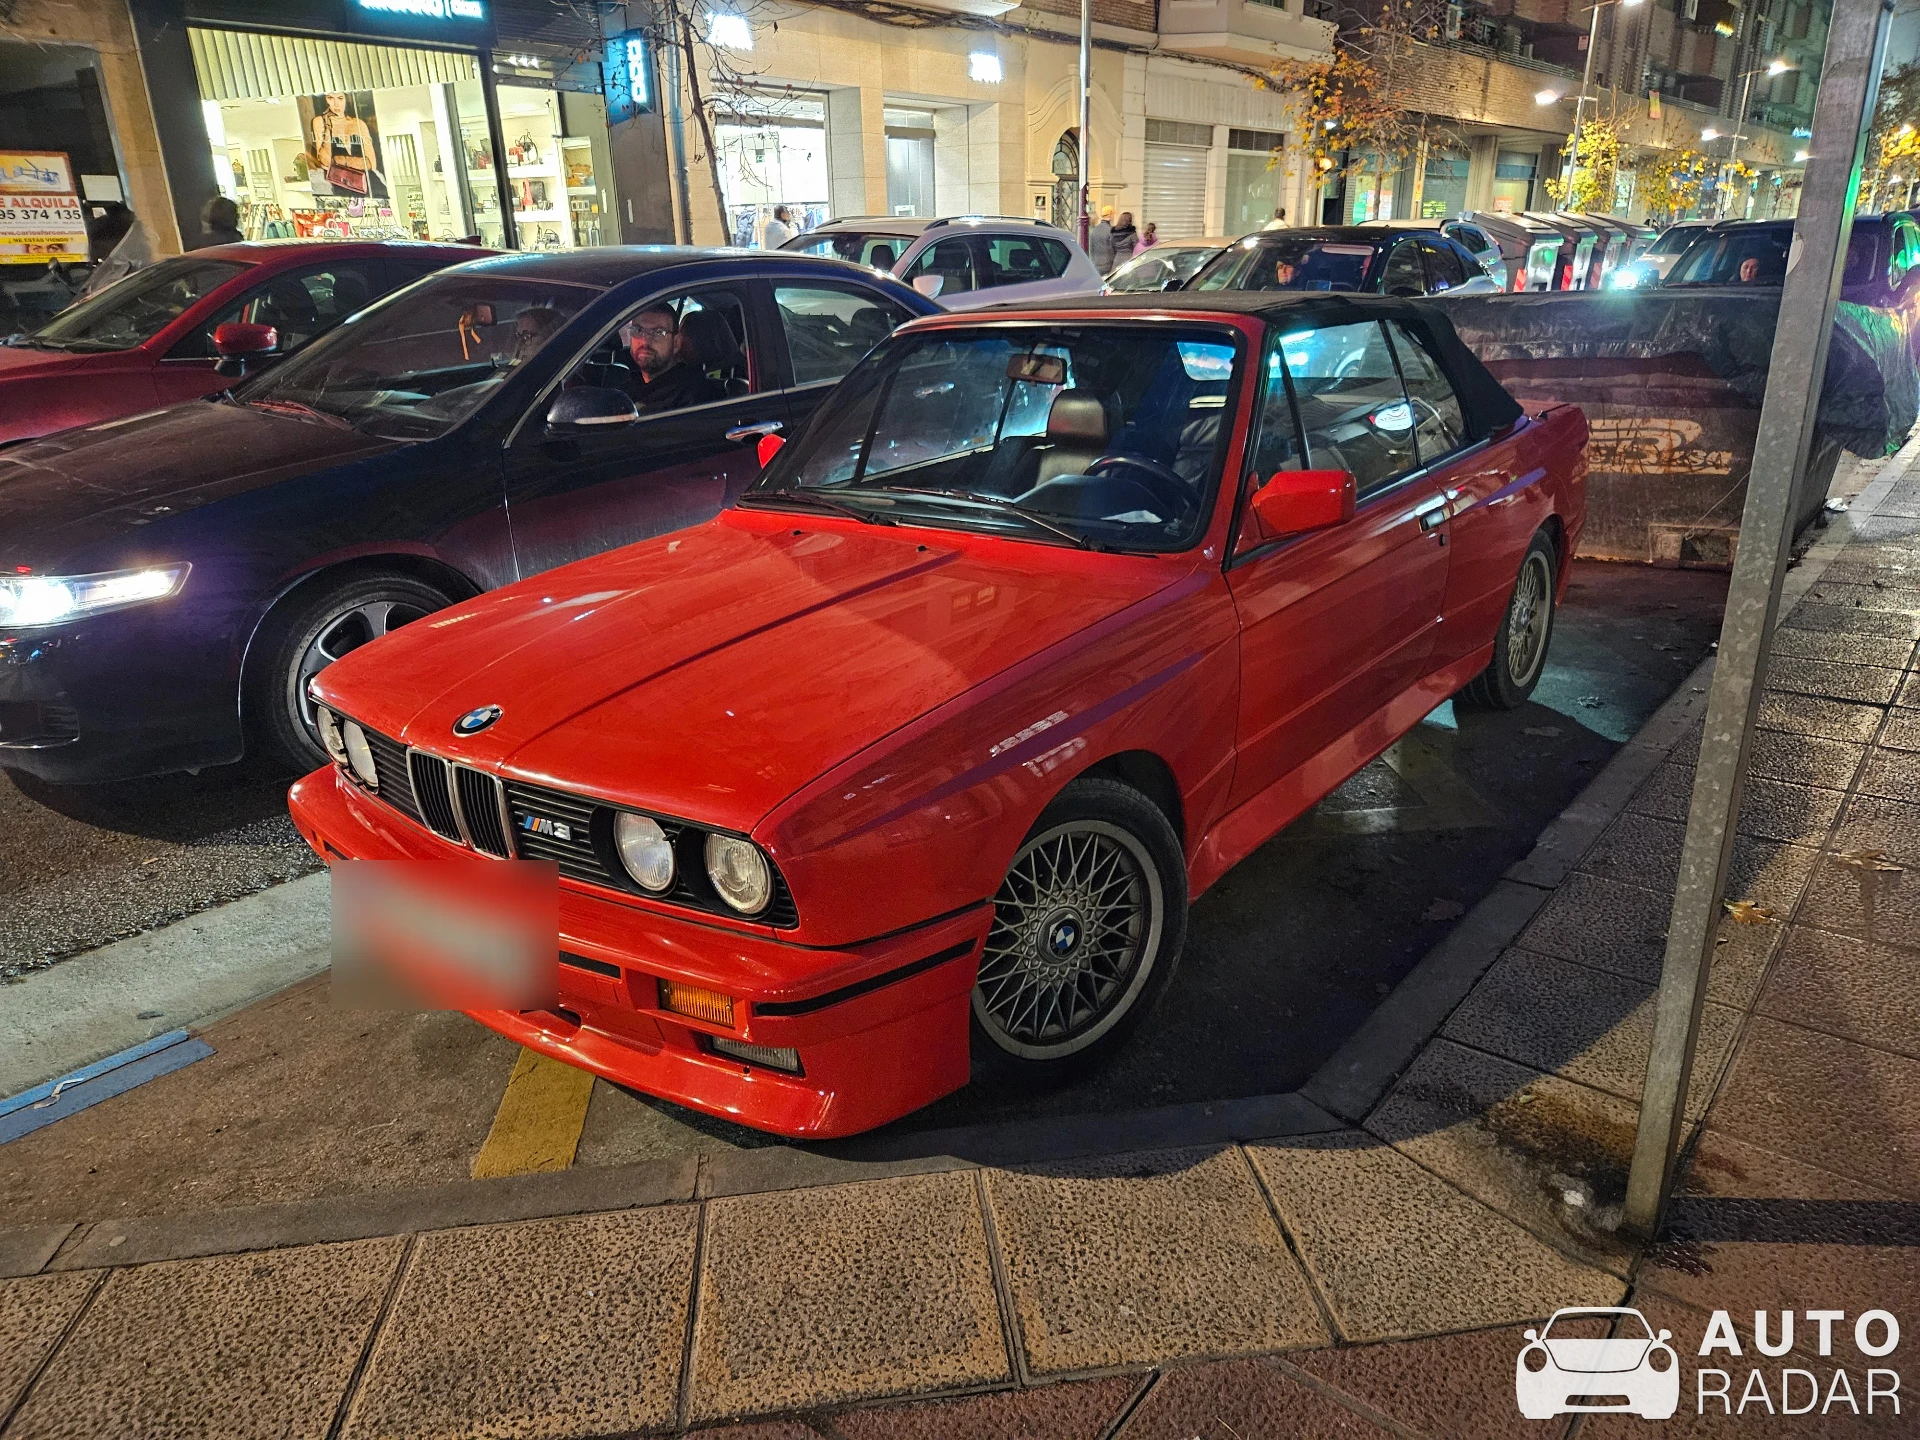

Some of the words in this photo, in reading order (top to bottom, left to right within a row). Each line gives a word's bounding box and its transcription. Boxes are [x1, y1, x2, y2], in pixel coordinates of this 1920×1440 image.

[11, 197, 78, 208] ALQUILA
[21, 209, 49, 219] 374
[54, 209, 82, 219] 135
